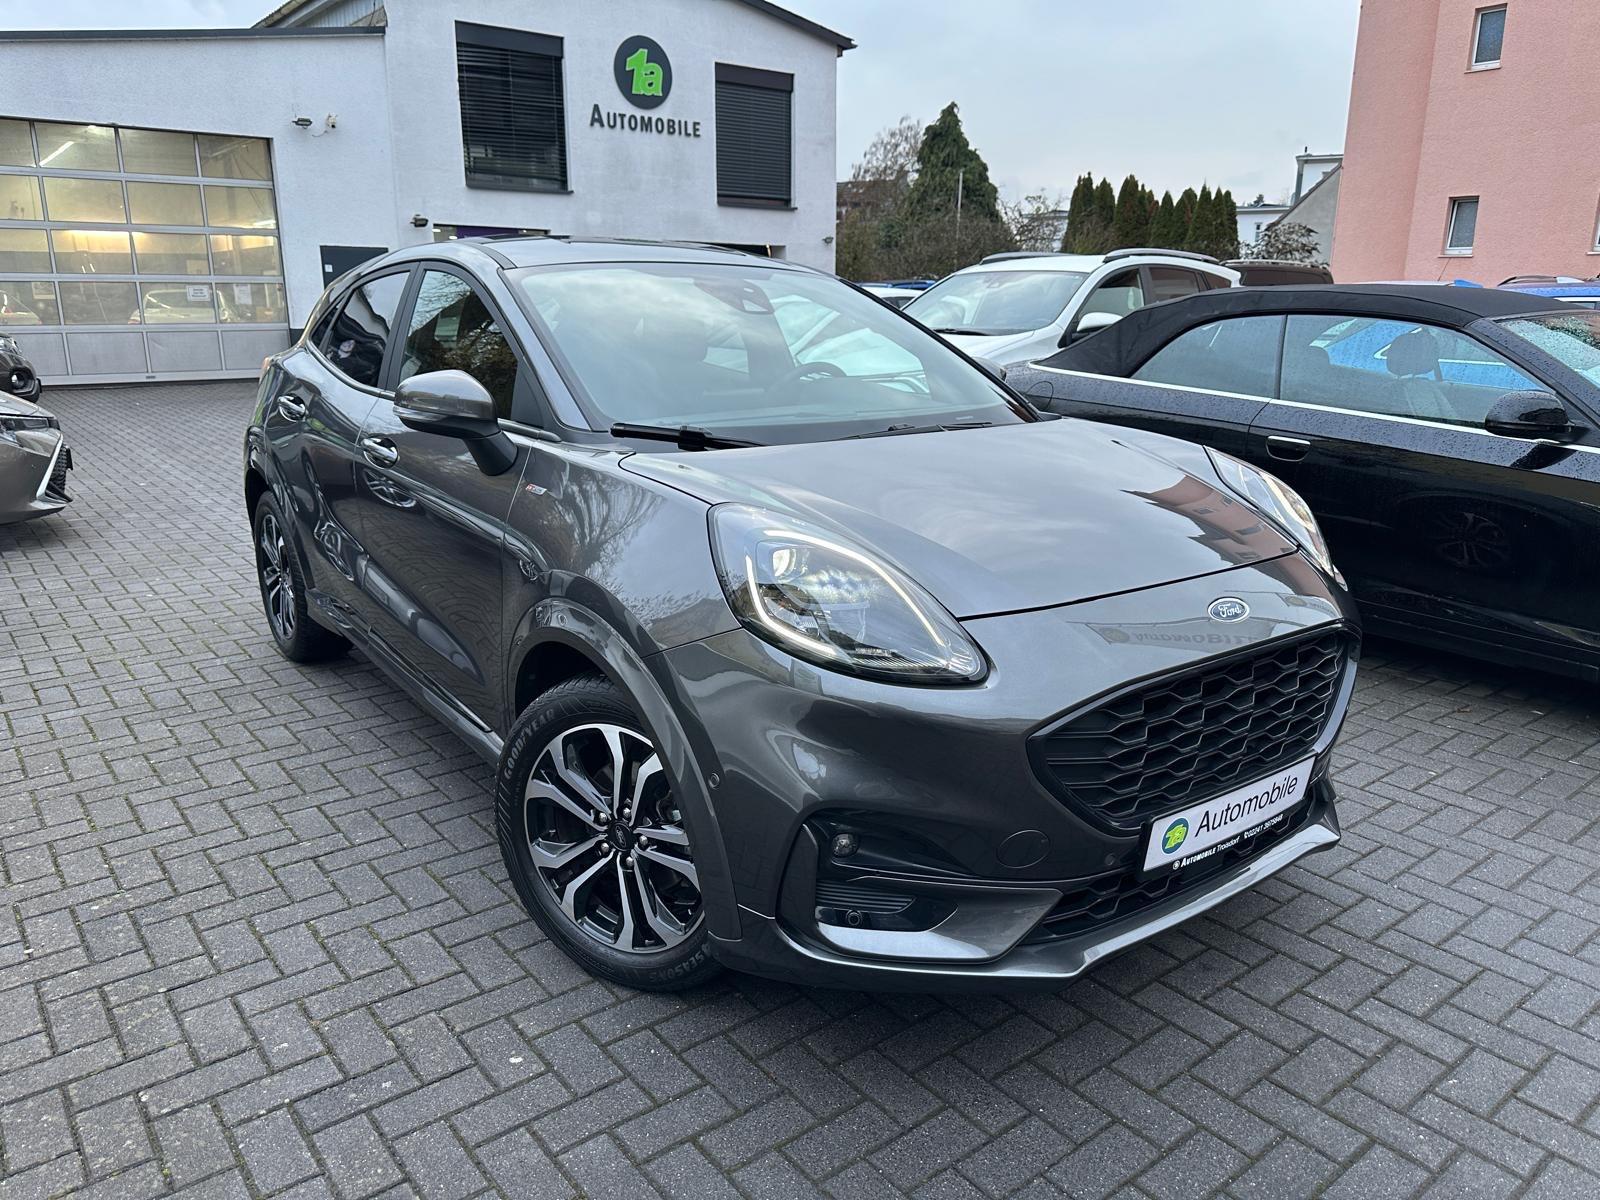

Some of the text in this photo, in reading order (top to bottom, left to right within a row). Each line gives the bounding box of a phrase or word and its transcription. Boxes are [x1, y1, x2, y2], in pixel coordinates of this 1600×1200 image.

[625, 48, 663, 96] 1a
[589, 103, 702, 138] AUTOMOBILE
[1217, 602, 1242, 618] Ford
[1194, 775, 1299, 838] Automobile
